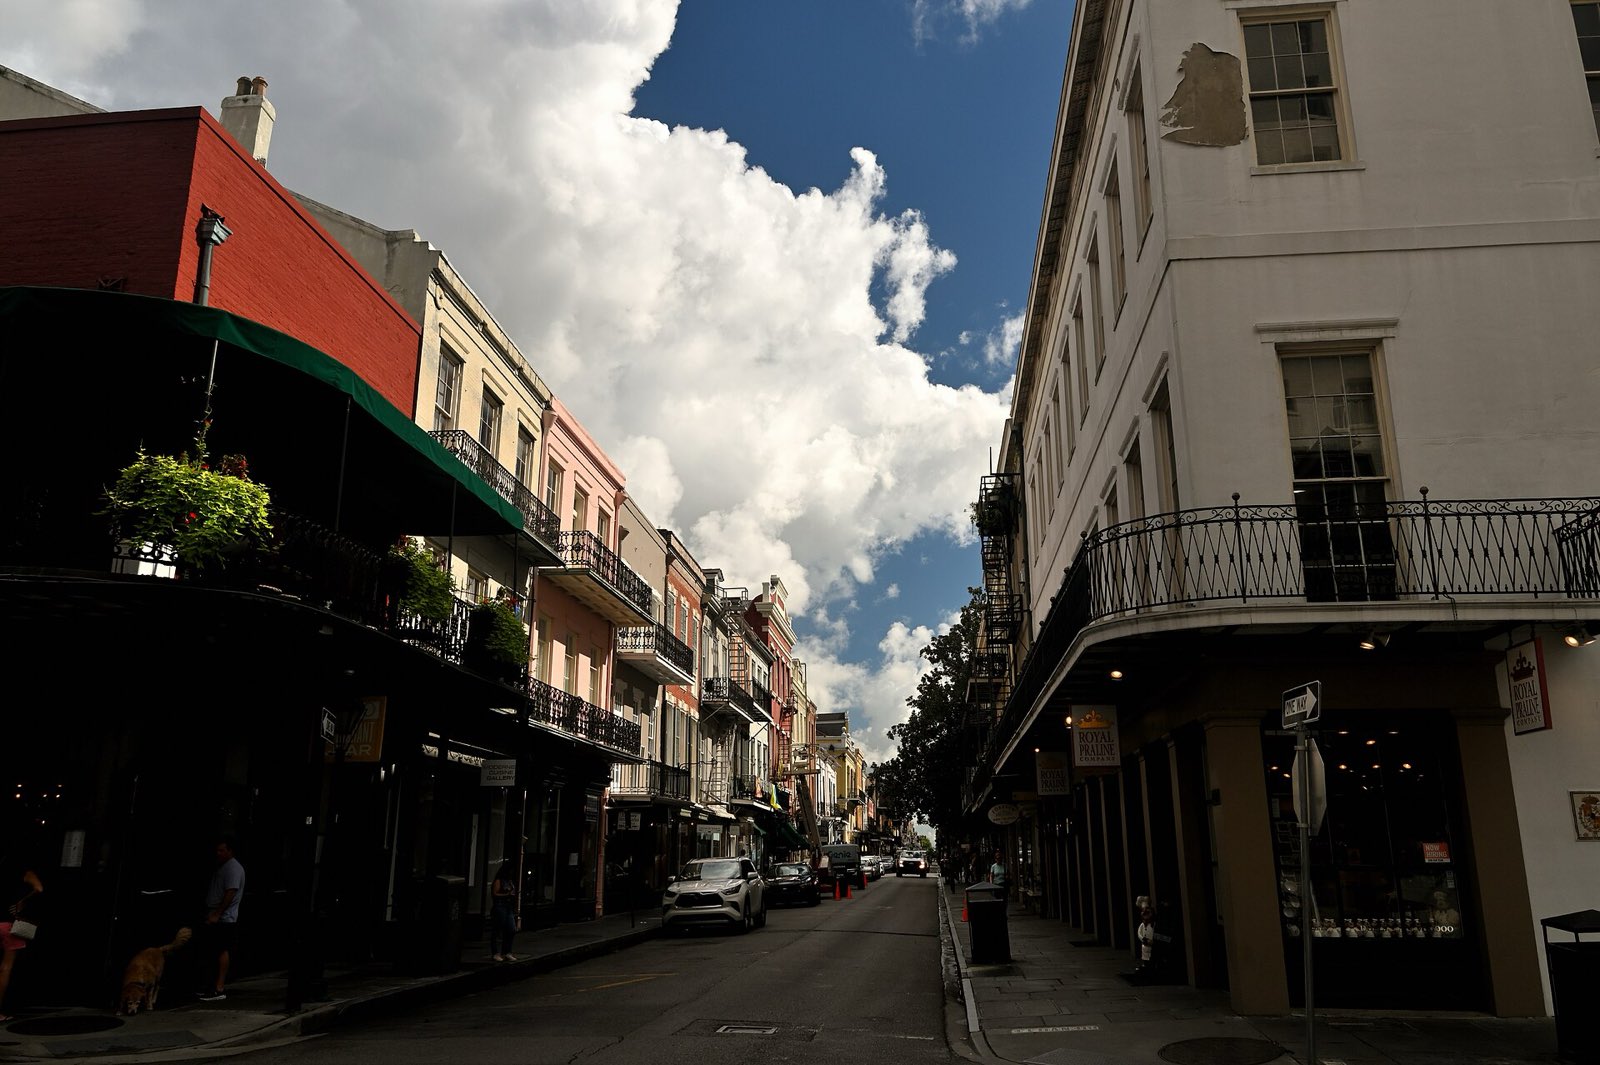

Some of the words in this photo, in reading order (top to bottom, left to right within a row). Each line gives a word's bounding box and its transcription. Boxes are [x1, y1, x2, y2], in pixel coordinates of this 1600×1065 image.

[1513, 680, 1537, 701] ROYAL
[1285, 699, 1296, 715] ONE
[1296, 695, 1308, 712] WAY
[1515, 697, 1540, 719] PRALINE
[1079, 731, 1114, 743] ROYAL
[1079, 744, 1115, 756] PRALINE
[1041, 770, 1066, 779] ROYAL
[1424, 843, 1440, 851] NOW
